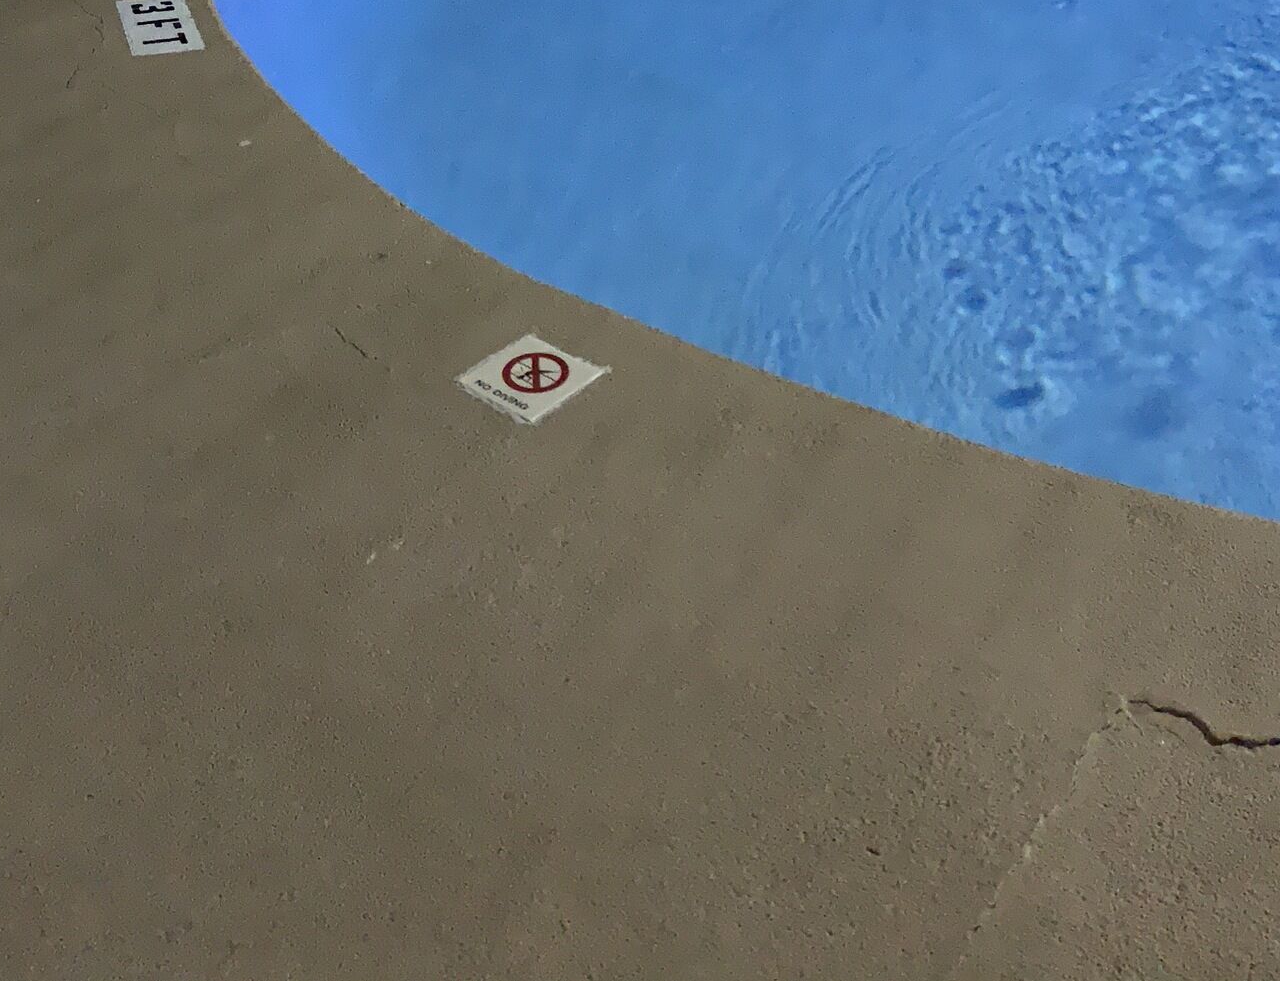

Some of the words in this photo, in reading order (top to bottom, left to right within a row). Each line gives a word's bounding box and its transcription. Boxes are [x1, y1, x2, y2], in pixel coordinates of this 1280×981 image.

[130, 0, 176, 15] 3
[136, 17, 189, 45] FT
[474, 379, 492, 391] NO
[492, 389, 530, 411] DIVING
